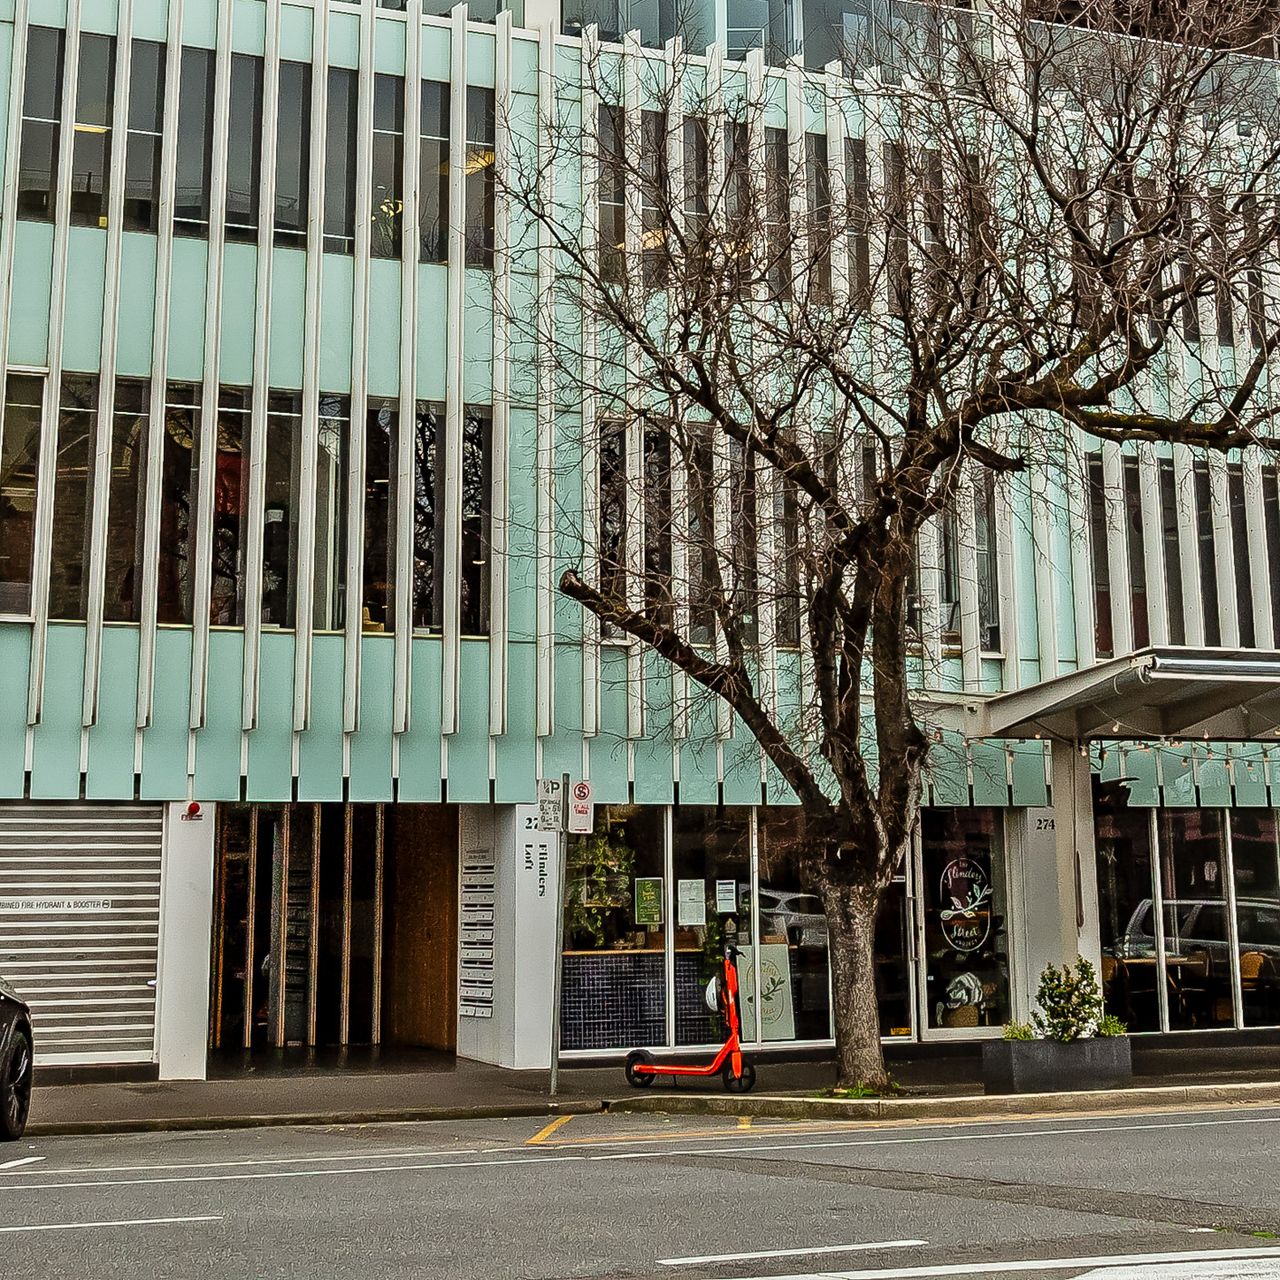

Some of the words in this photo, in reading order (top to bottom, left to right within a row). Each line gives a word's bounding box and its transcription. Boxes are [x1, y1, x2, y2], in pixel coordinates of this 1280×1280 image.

[525, 817, 538, 829] 27
[1036, 819, 1055, 830] 274
[525, 844, 533, 870] Loft
[539, 844, 548, 896] Flinders
[21, 901, 34, 909] FIRE
[35, 900, 65, 909] HYDRANT
[66, 901, 72, 909] &
[73, 900, 101, 908] BOOSTER
